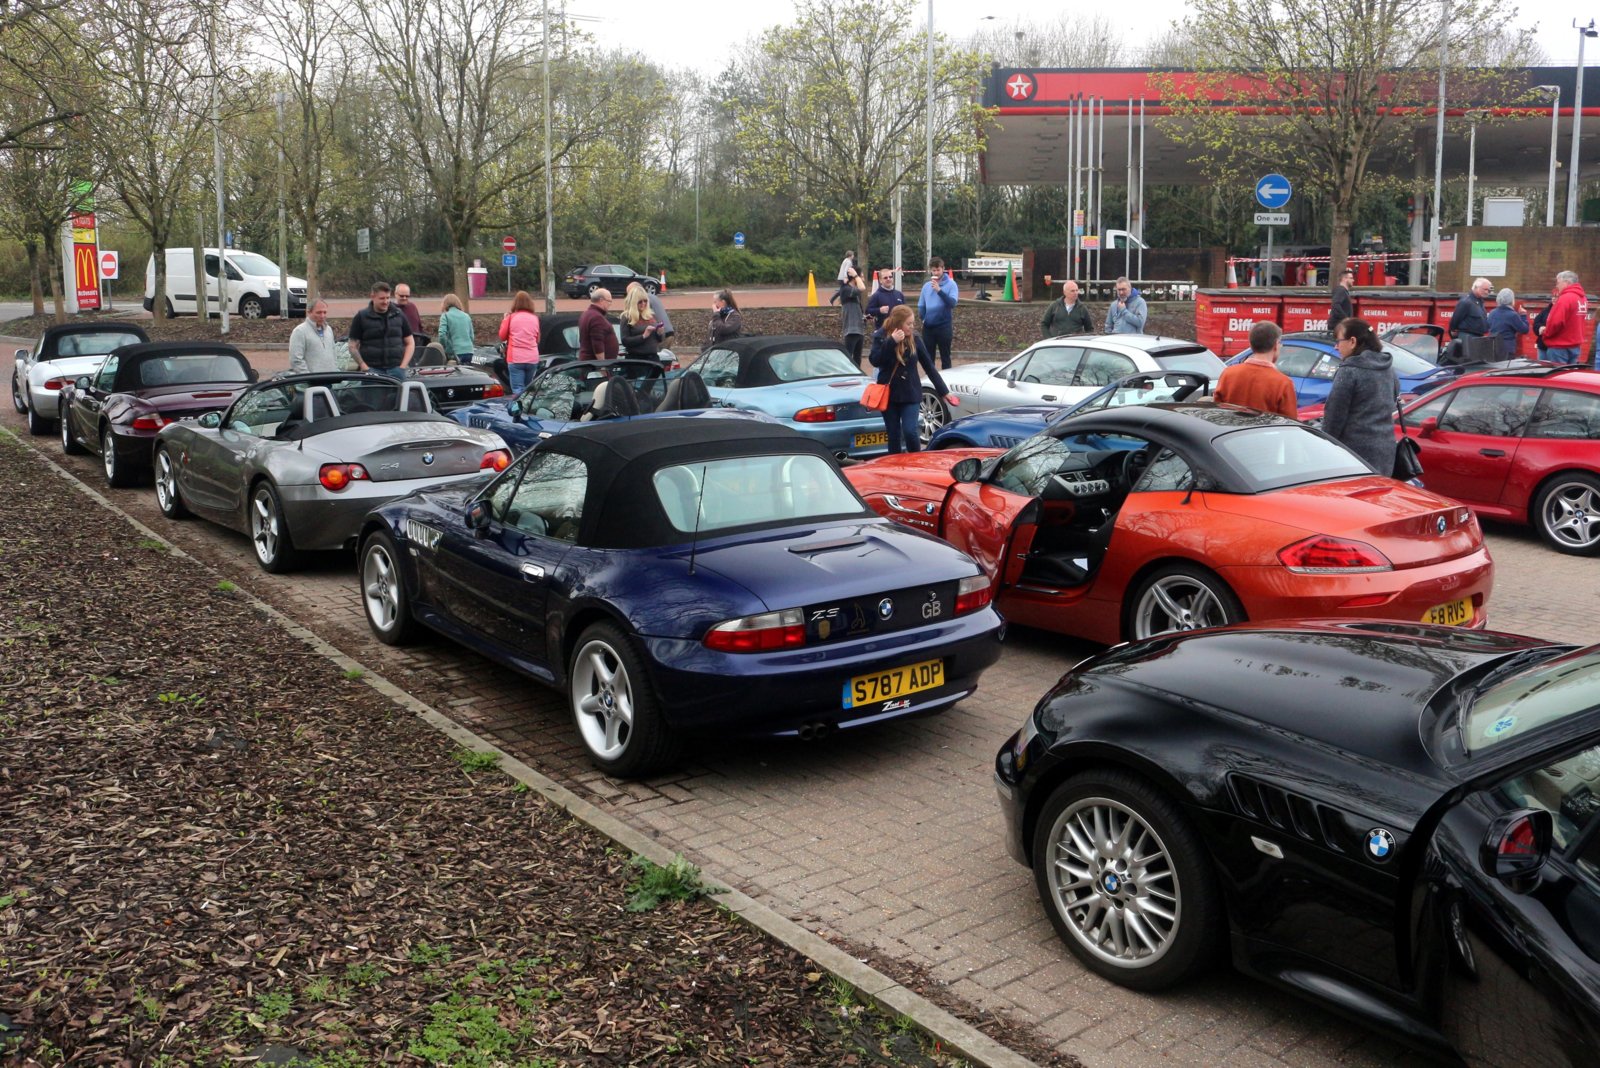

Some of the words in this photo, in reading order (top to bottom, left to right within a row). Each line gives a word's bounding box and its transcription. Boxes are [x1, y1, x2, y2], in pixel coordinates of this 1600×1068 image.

[1228, 318, 1256, 331] Biff
[1303, 319, 1328, 332] Biff
[855, 434, 877, 445] P253
[380, 462, 400, 470] Z4
[810, 607, 840, 621] Z3
[922, 602, 941, 619] GB
[1447, 601, 1466, 623] RVS
[855, 671, 903, 703] S787
[909, 662, 941, 690] ADP
[1369, 830, 1394, 845] BMW
